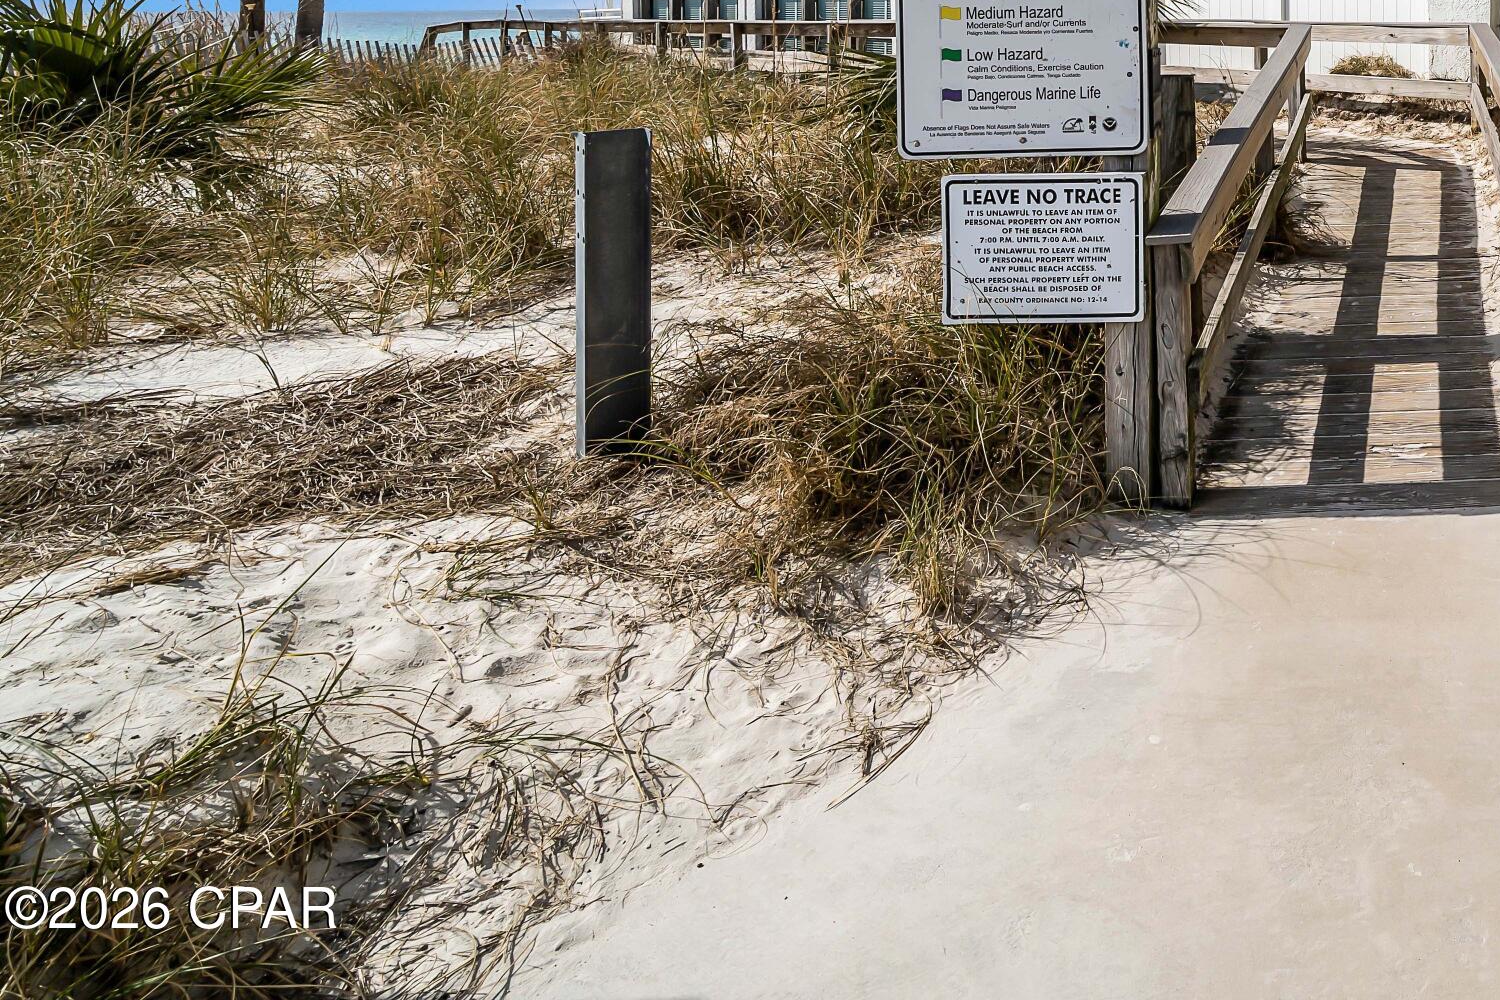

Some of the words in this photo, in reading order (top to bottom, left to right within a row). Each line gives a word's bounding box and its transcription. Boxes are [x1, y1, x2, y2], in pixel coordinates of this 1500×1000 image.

[966, 6, 1015, 19] Medium
[1019, 5, 1064, 19] Hazard
[1025, 20, 1050, 28] and/or
[967, 48, 993, 62] Low
[997, 48, 1043, 61] Hazard
[967, 65, 989, 73] Calm
[990, 64, 1035, 73] Conditions,
[1037, 64, 1071, 72] Exercise
[1073, 63, 1104, 71] Caution
[967, 88, 1032, 103] Dangerous
[1035, 87, 1076, 101] Marine
[1080, 86, 1101, 99] Life
[963, 189, 1020, 205] LEAVE
[1026, 189, 1057, 205] NO
[1063, 188, 1121, 204] TRACE
[993, 247, 1037, 255] UNLAWFUL
[1092, 246, 1111, 254] ITEM
